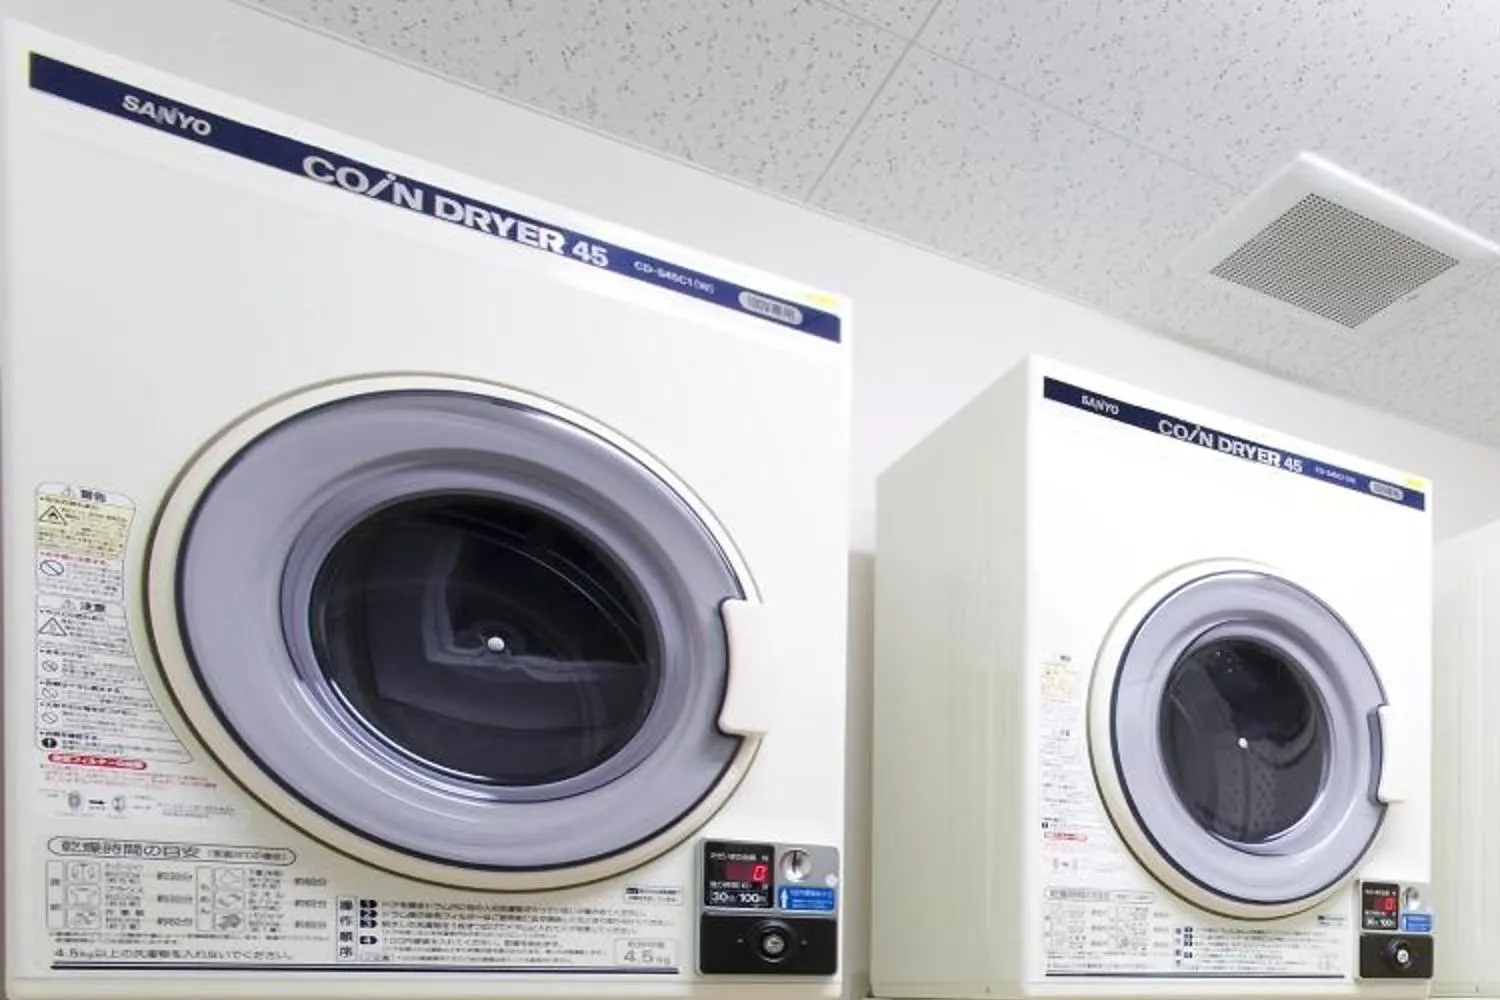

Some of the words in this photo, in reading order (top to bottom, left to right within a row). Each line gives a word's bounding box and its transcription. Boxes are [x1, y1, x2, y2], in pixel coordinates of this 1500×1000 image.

[121, 95, 212, 136] SANYO
[434, 195, 565, 254] DRYER
[571, 240, 609, 268] 45
[1081, 395, 1119, 415] SANYO
[1218, 436, 1281, 468] DRYER
[1283, 457, 1303, 474] 45
[752, 864, 767, 881] 0
